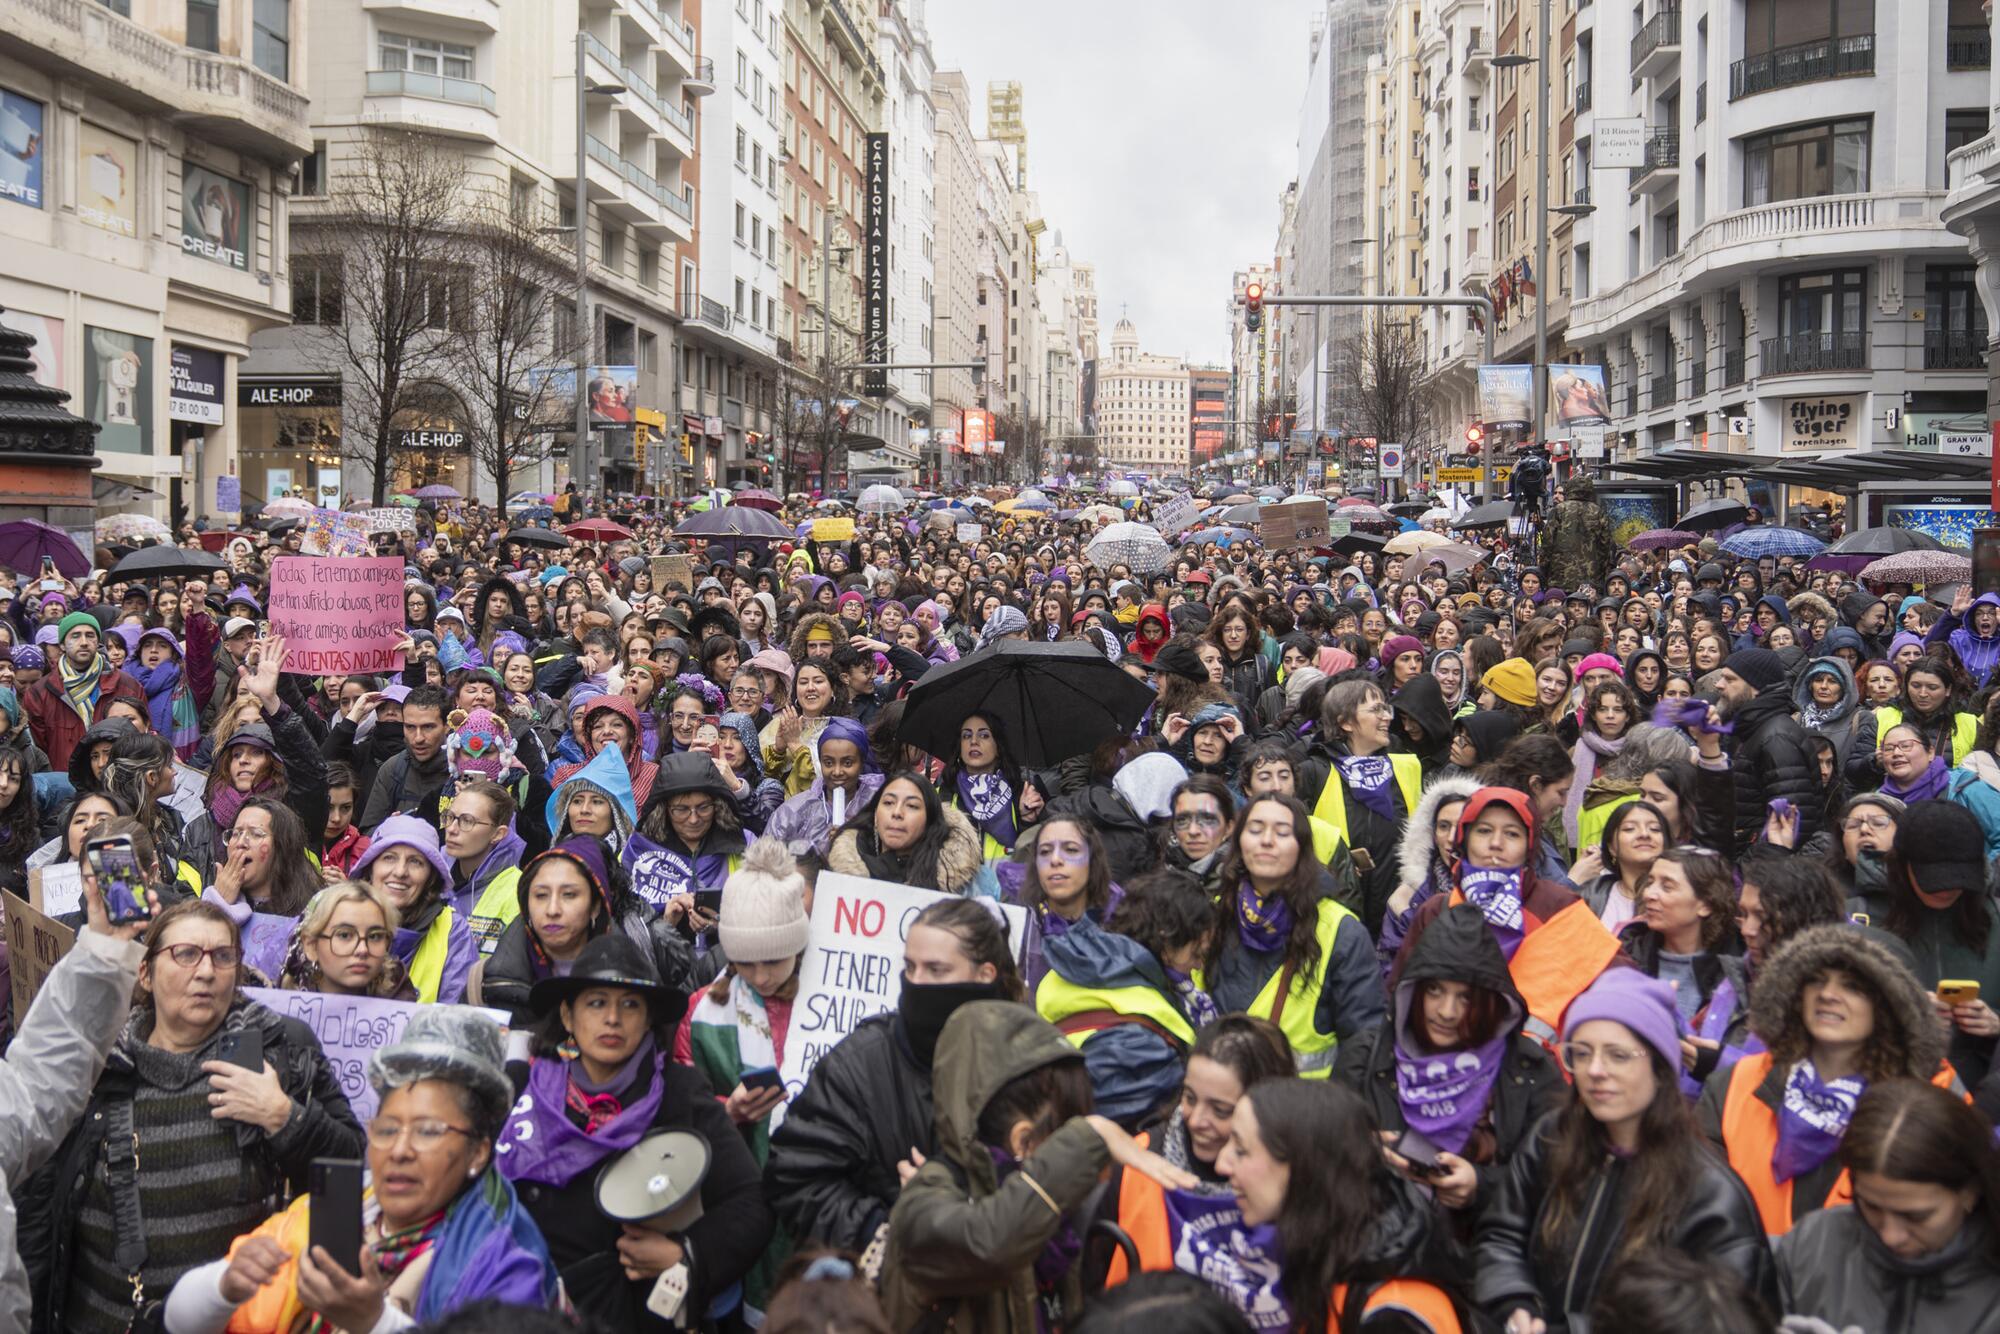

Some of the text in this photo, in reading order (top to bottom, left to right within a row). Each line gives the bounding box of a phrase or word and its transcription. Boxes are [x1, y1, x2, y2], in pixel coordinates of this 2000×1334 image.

[1600, 140, 1608, 148] de
[872, 140, 882, 238] CATALONIA
[77, 204, 133, 232] CREATE
[181, 234, 245, 267] CREATE
[872, 245, 881, 300] PLAZA
[176, 379, 215, 396] ALQUILER
[251, 388, 313, 403] ALE-HOP
[1790, 400, 1851, 420] flying
[401, 431, 464, 447] ALE-HOP
[1792, 418, 1848, 438] tiger
[1792, 438, 1848, 447] copenhagen
[1959, 445, 1971, 453] 69
[371, 518, 411, 530] PODER
[274, 560, 306, 584] Todas
[362, 566, 401, 586] amigas
[286, 590, 300, 609] han
[302, 590, 335, 611] sufrido
[337, 590, 373, 614] abusos,
[375, 593, 400, 612] pero
[290, 619, 313, 640] tiene
[315, 624, 349, 643] amigos
[298, 651, 350, 671] CUENTAS
[353, 651, 371, 670] NO
[373, 649, 396, 669] DAN
[833, 895, 886, 937] NO
[818, 947, 891, 996] TENER
[800, 993, 866, 1035] SALIR
